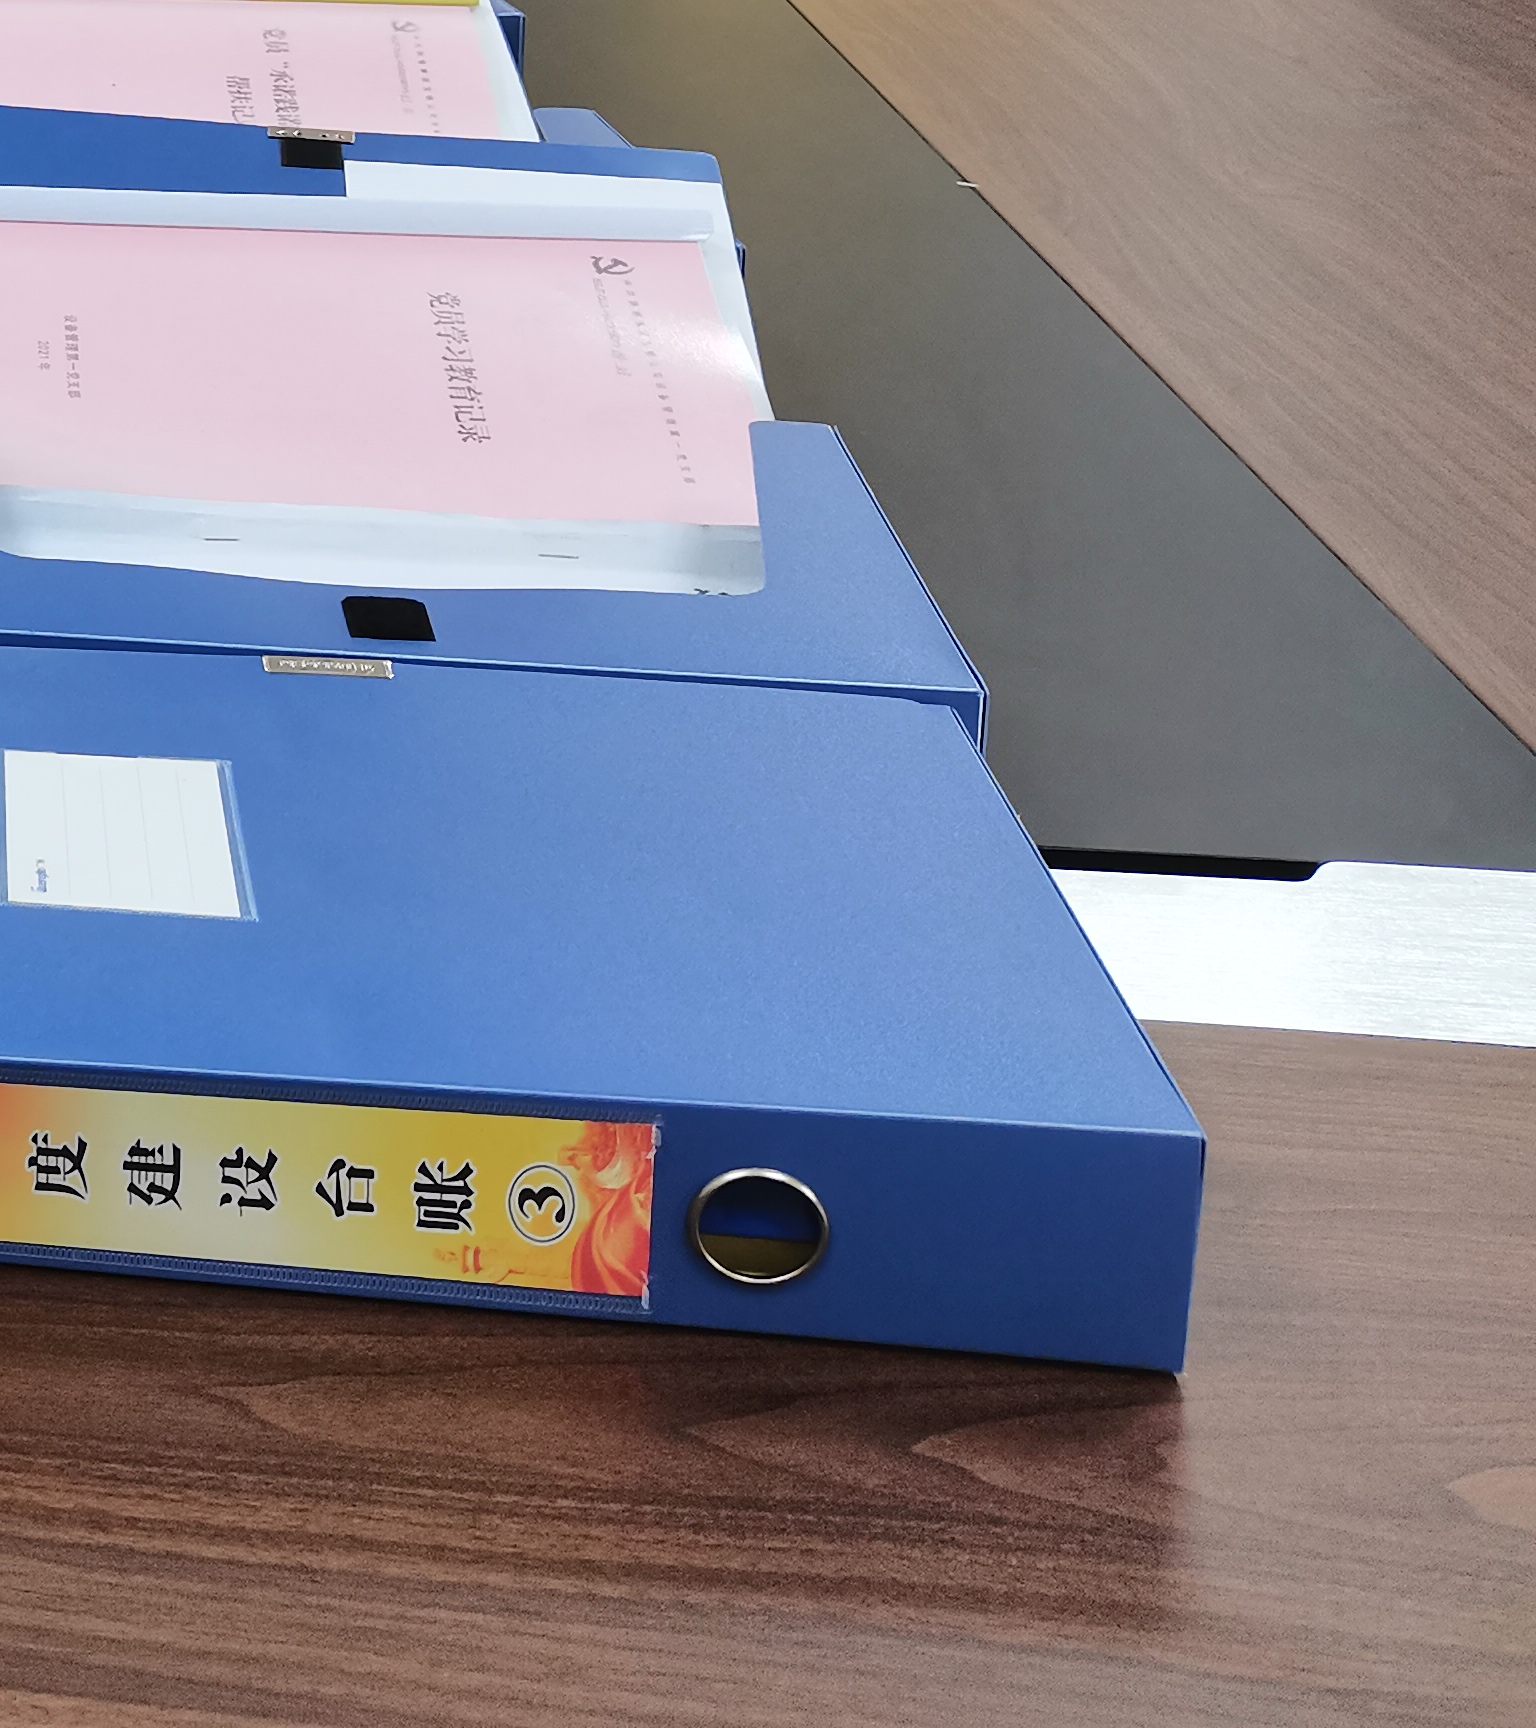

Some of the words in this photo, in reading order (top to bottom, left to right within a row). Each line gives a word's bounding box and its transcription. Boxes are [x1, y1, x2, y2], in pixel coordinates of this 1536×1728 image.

[425, 290, 493, 444] 党员学习教育记录
